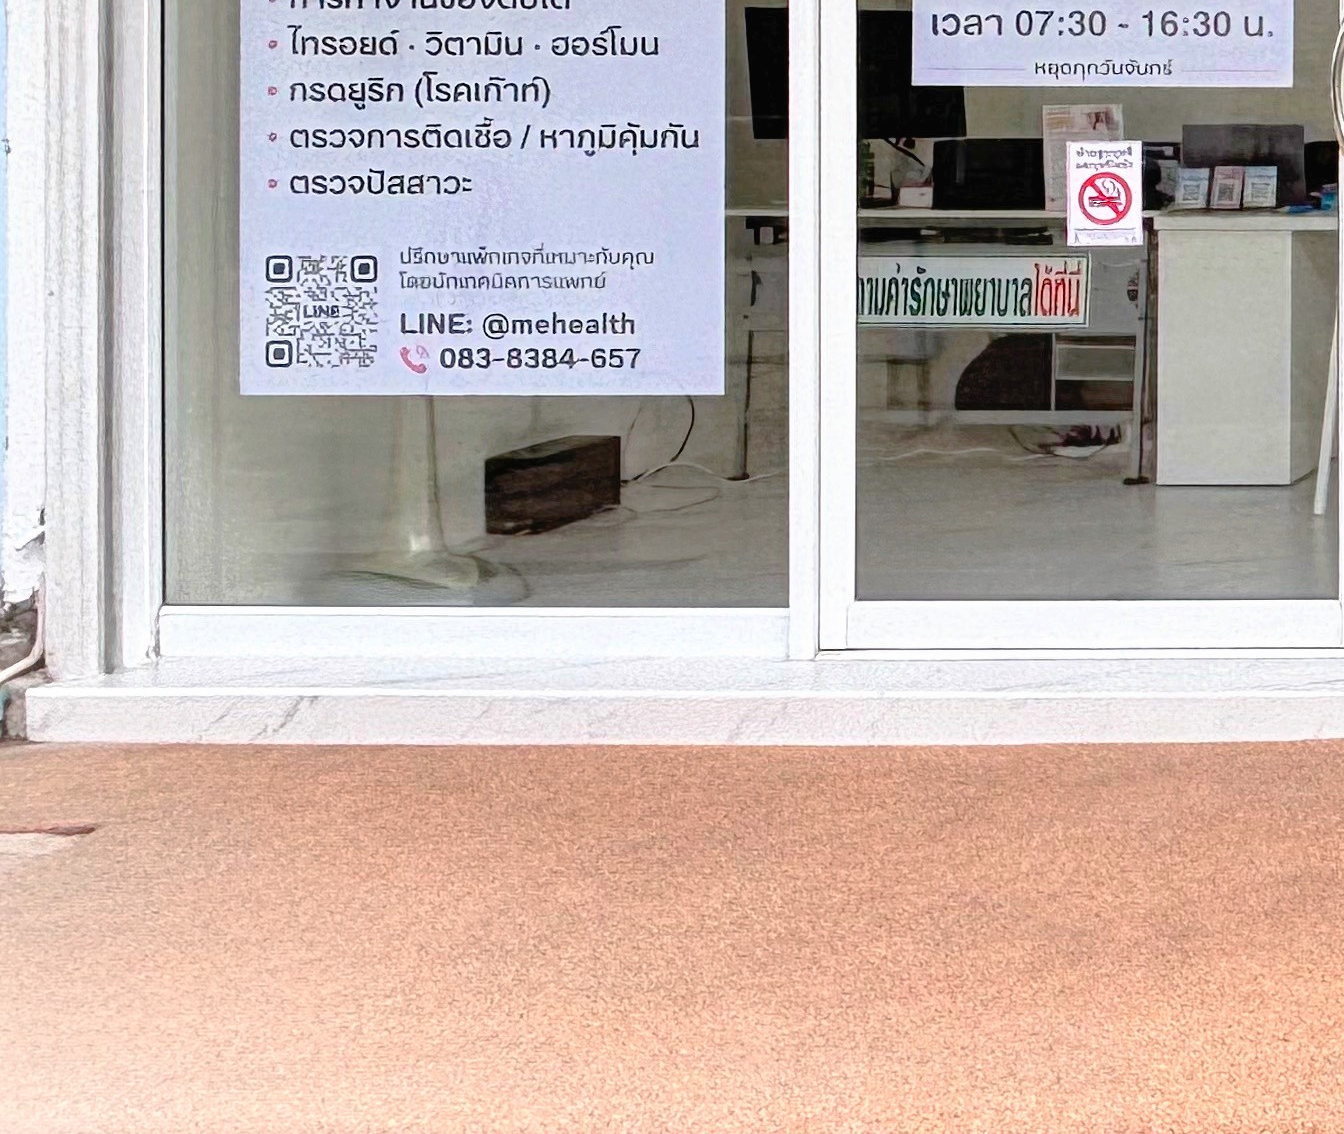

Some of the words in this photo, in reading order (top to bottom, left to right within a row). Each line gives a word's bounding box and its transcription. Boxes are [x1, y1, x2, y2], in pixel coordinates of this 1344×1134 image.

[931, 11, 1004, 38] เวลา
[1014, 9, 1107, 38] 07:30
[1142, 9, 1232, 38] 16:30
[1243, 14, 1274, 38] น.
[287, 24, 399, 57] ไทรอยด์
[424, 31, 524, 57] วิตามิน
[551, 25, 661, 57] ฮอร์โมน
[1034, 57, 1174, 82] หยุดทุกวันจันทร์
[289, 76, 405, 110] กรดยูริก
[289, 117, 513, 151] ตรวจการติดเชื้อ
[539, 122, 700, 158] หาภูมิคุ้มกัน
[289, 167, 474, 196] ตรวจปัสสาวะ
[399, 312, 474, 335] LINE:
[482, 311, 636, 340] @mehealth
[439, 346, 641, 370] 083-8384-657
